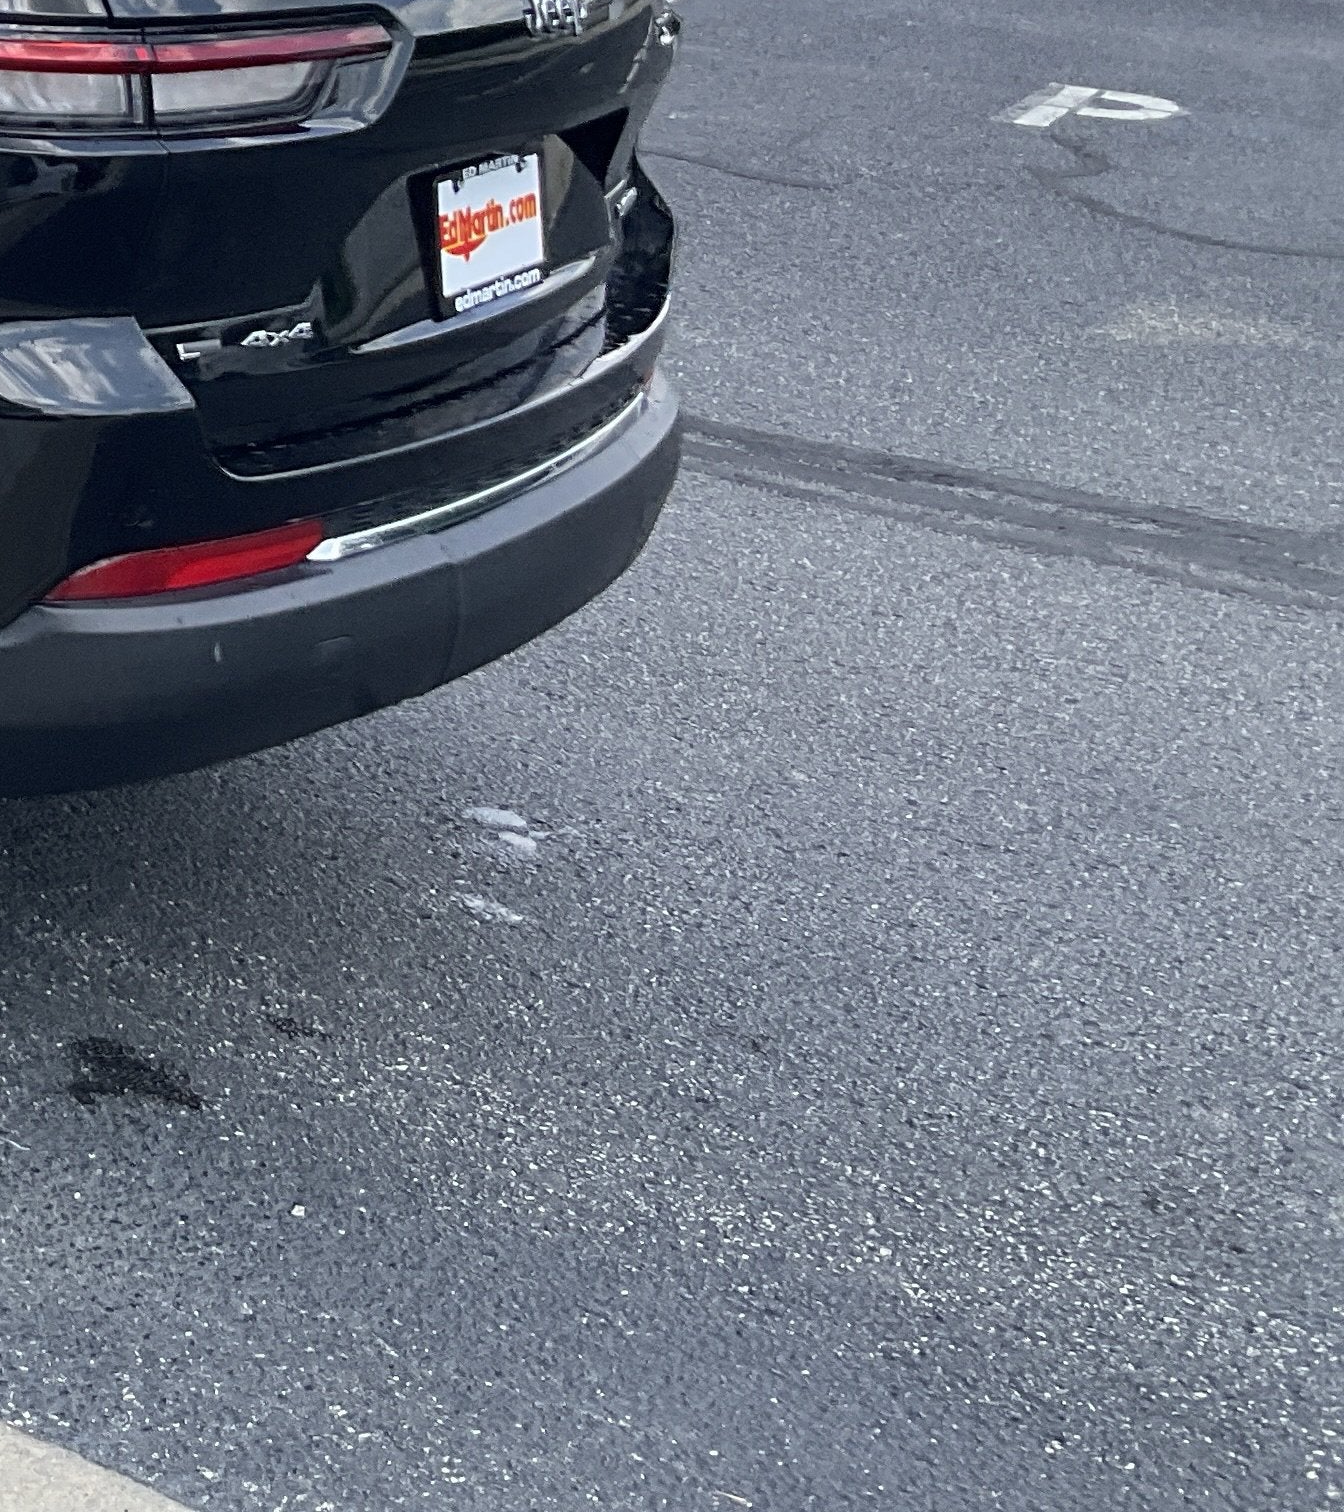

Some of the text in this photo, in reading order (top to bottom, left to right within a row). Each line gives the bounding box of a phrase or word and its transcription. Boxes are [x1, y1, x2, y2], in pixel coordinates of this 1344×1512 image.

[462, 154, 520, 180] ED MARTIN
[438, 192, 537, 251] EdMartin.com
[454, 267, 541, 313] edmartin.com
